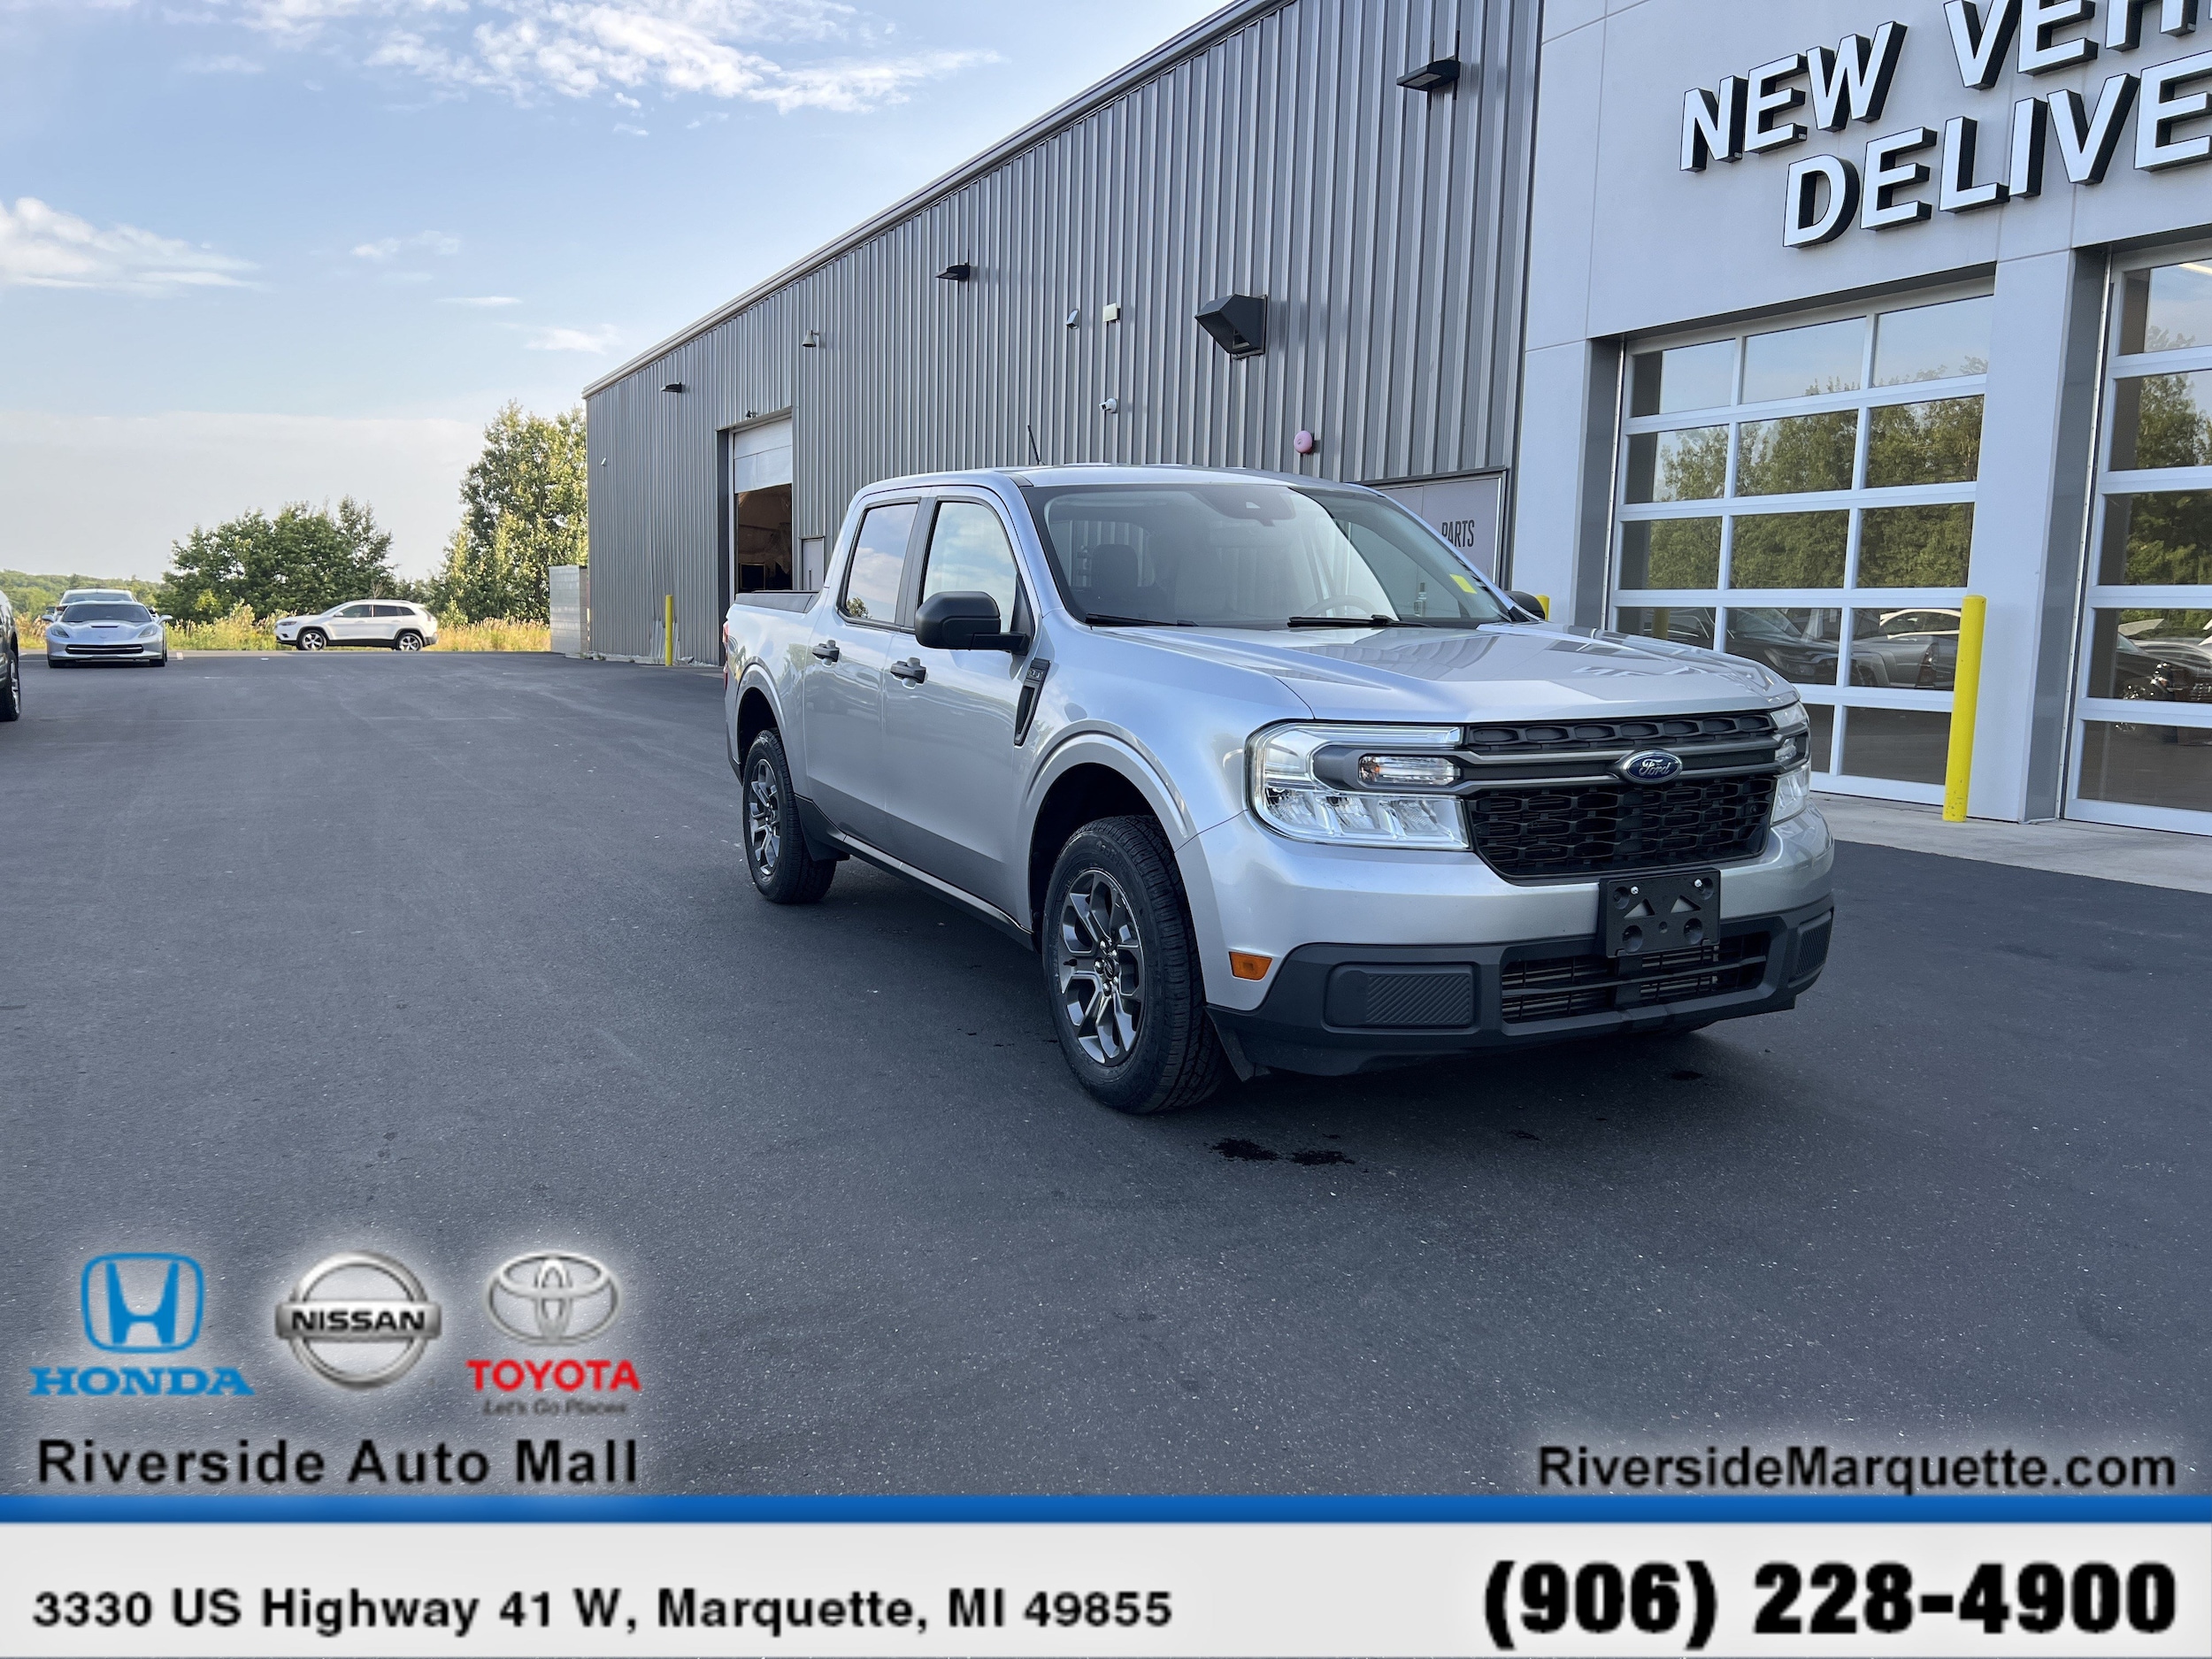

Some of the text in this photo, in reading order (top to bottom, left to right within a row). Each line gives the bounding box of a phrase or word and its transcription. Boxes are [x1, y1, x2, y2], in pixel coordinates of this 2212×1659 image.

[1680, 20, 1908, 173] NEW
[1783, 50, 2212, 249] DELIVE
[1441, 519, 1475, 548] PARTS
[1639, 758, 1671, 776] Ford
